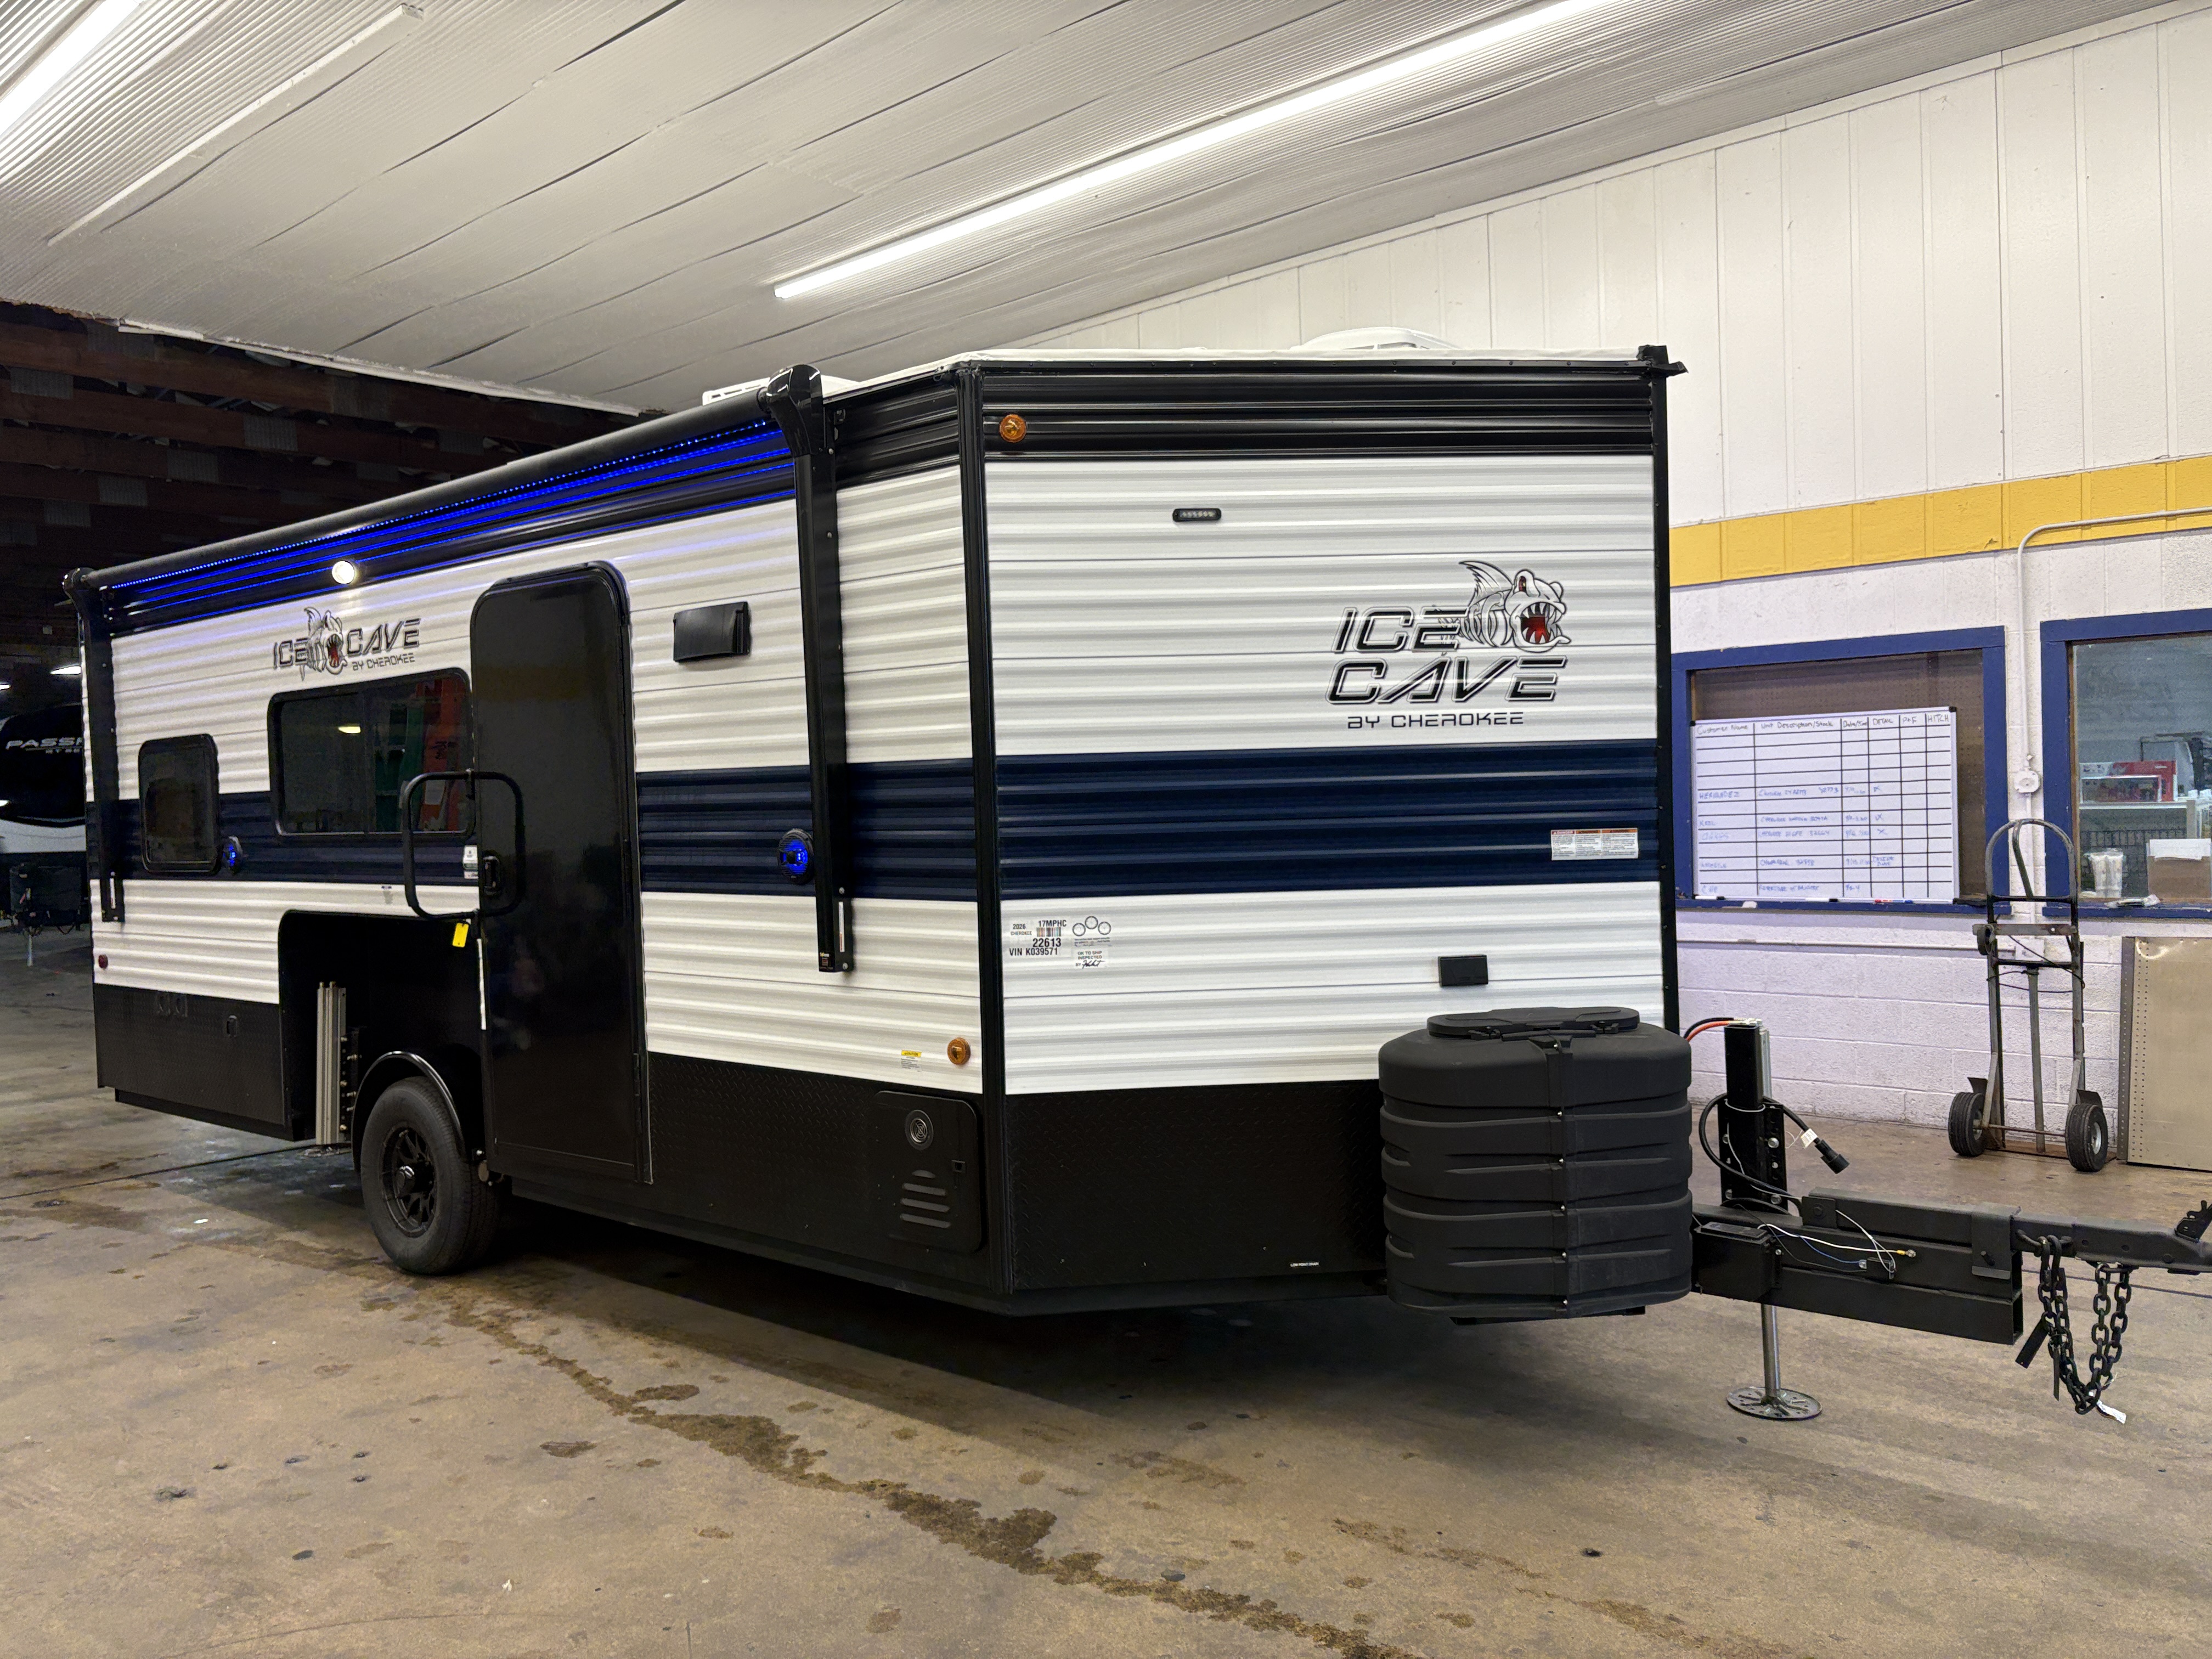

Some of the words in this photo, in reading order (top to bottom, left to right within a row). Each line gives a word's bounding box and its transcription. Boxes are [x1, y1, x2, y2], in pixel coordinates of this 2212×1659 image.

[1331, 606, 1470, 653] ICE
[273, 637, 309, 670] ICE
[346, 618, 421, 657] CAVE
[353, 661, 364, 671] BY
[366, 652, 415, 669] CHEROKEE
[1325, 655, 1567, 704] CAVE
[1347, 715, 1381, 729] BY
[1391, 712, 1524, 729] CHEROKEE
[1928, 714, 1949, 723] HITCH
[1697, 726, 1728, 735] Customer
[1032, 938, 1062, 947] 22613
[1009, 947, 1023, 956] VIN
[1025, 947, 1058, 956] K039571
